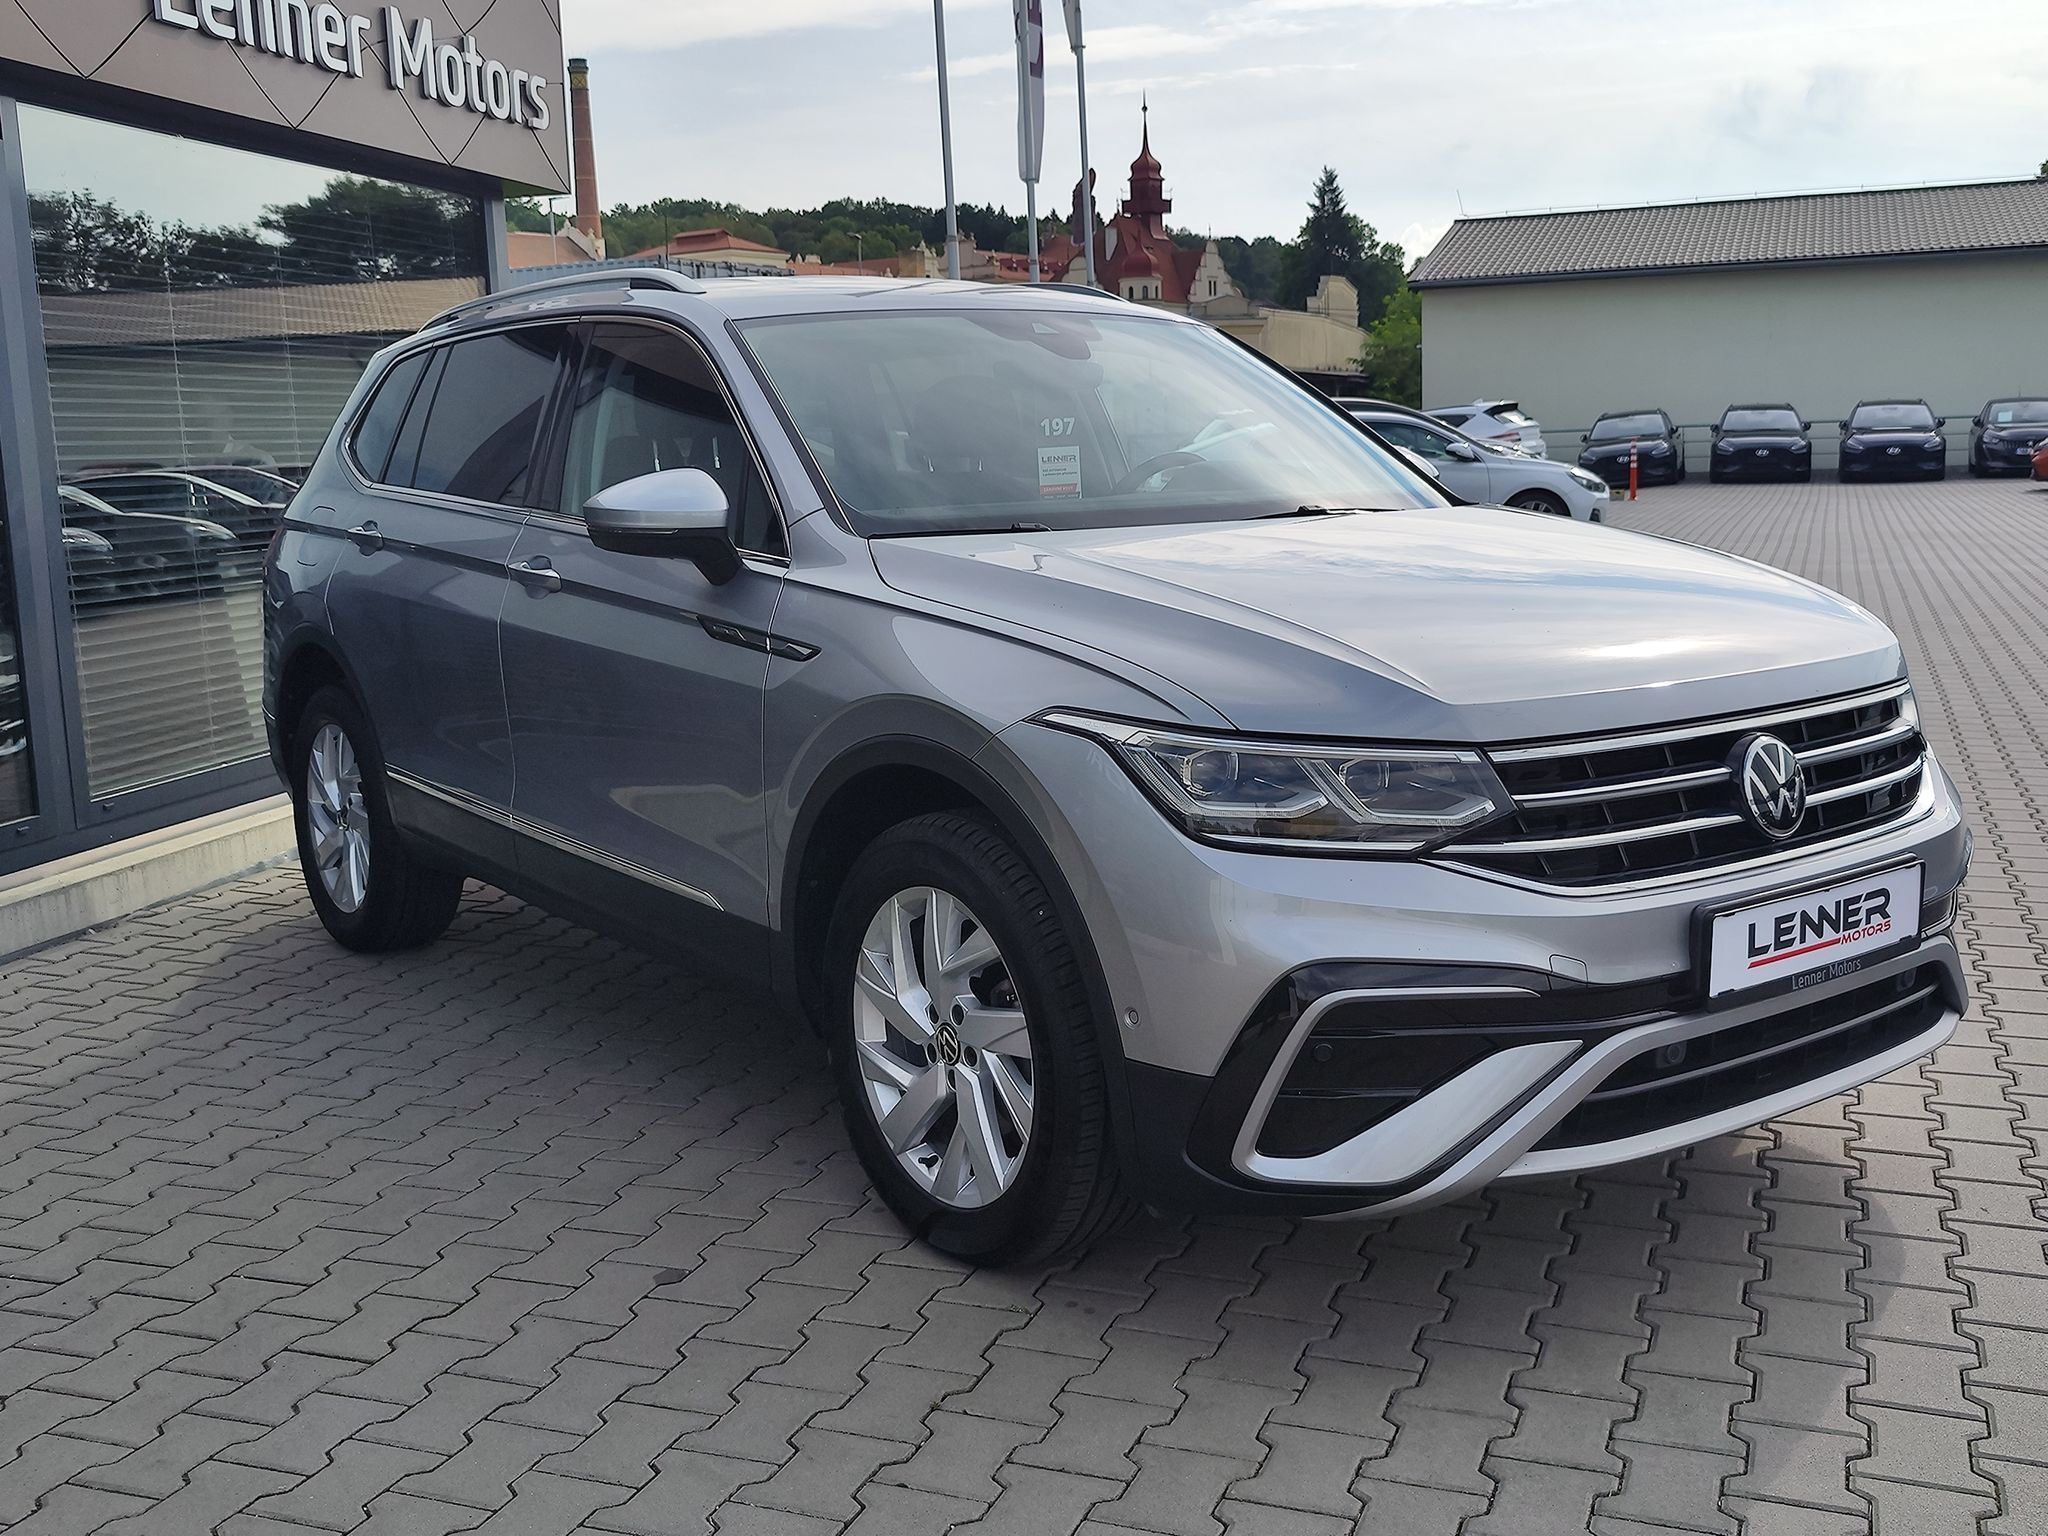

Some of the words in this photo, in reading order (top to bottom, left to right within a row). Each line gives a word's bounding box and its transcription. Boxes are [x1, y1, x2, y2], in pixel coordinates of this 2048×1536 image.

[382, 6, 549, 129] Motors
[1041, 417, 1075, 436] 197
[1747, 887, 1891, 958] LENNER
[1840, 920, 1892, 945] MOTORS
[1792, 969, 1826, 990] Lenner
[1828, 958, 1862, 977] Motors
